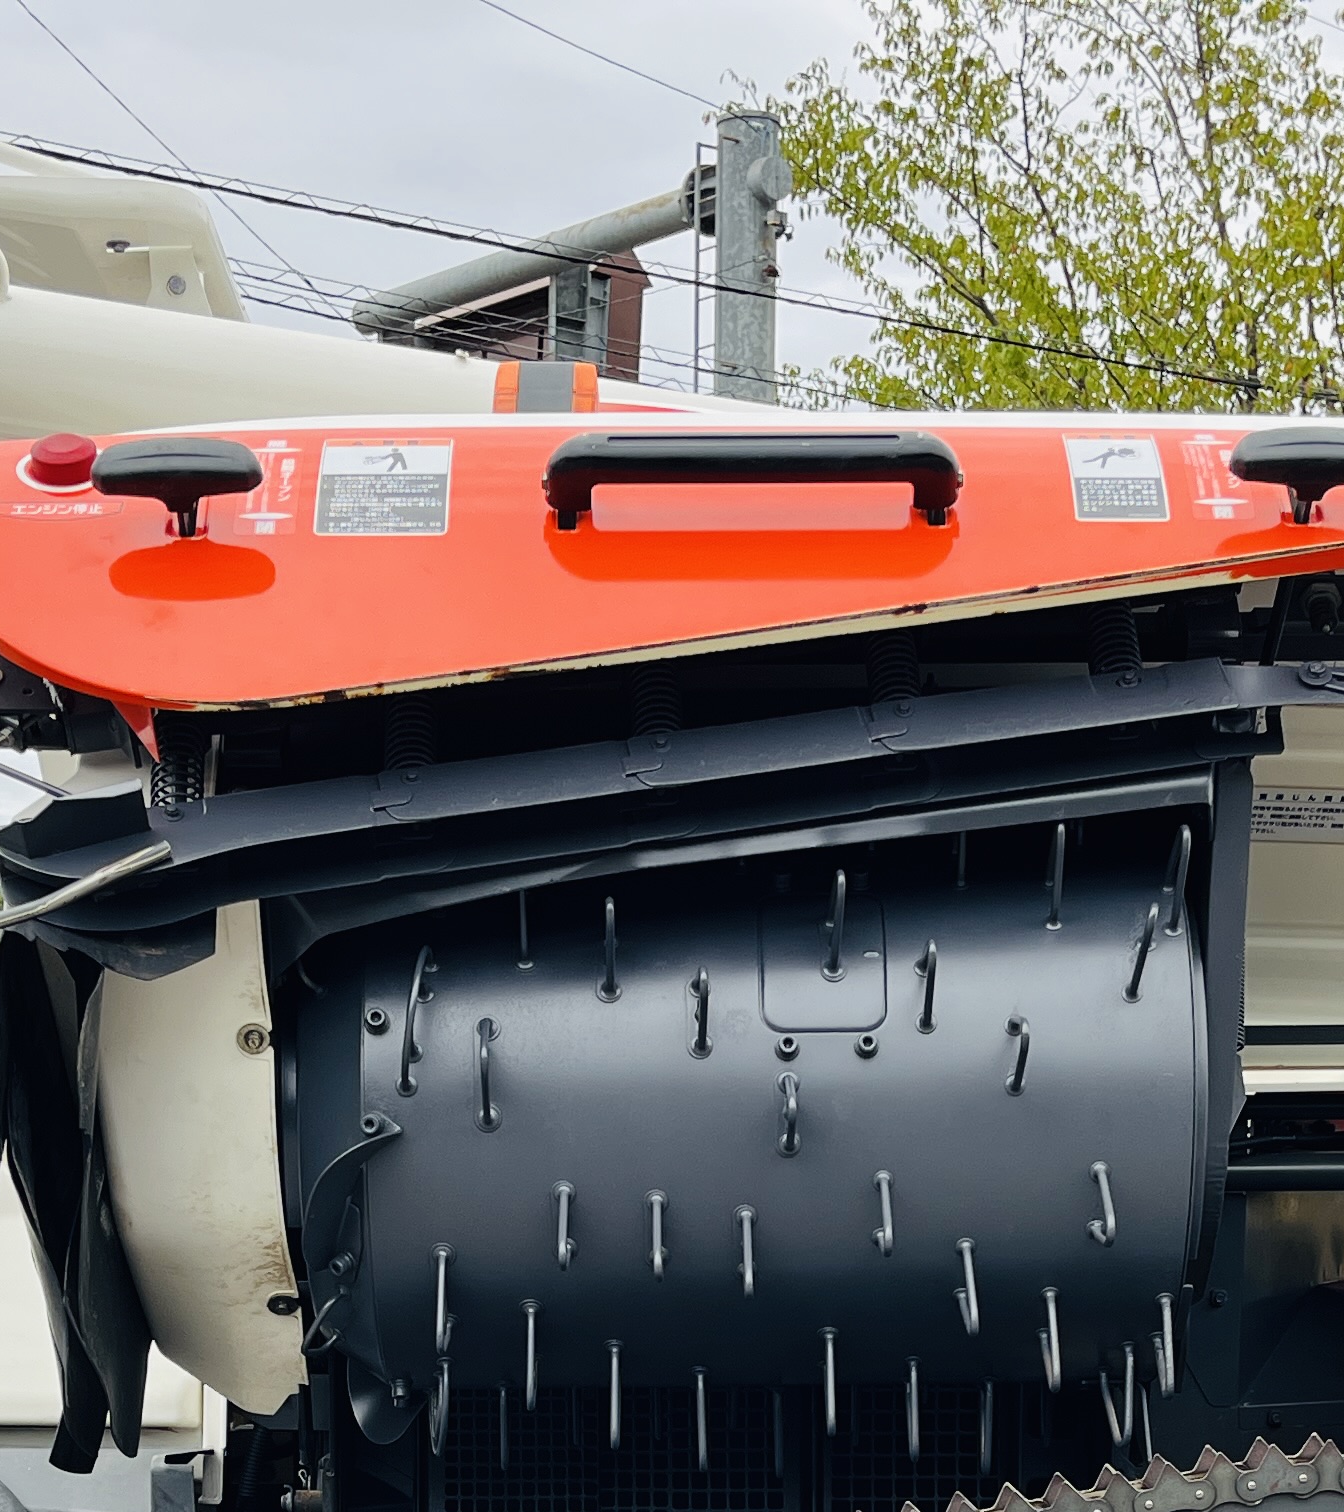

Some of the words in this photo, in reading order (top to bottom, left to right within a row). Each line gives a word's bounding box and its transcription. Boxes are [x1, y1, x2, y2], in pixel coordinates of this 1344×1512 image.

[10, 503, 103, 515] エンジン停止
